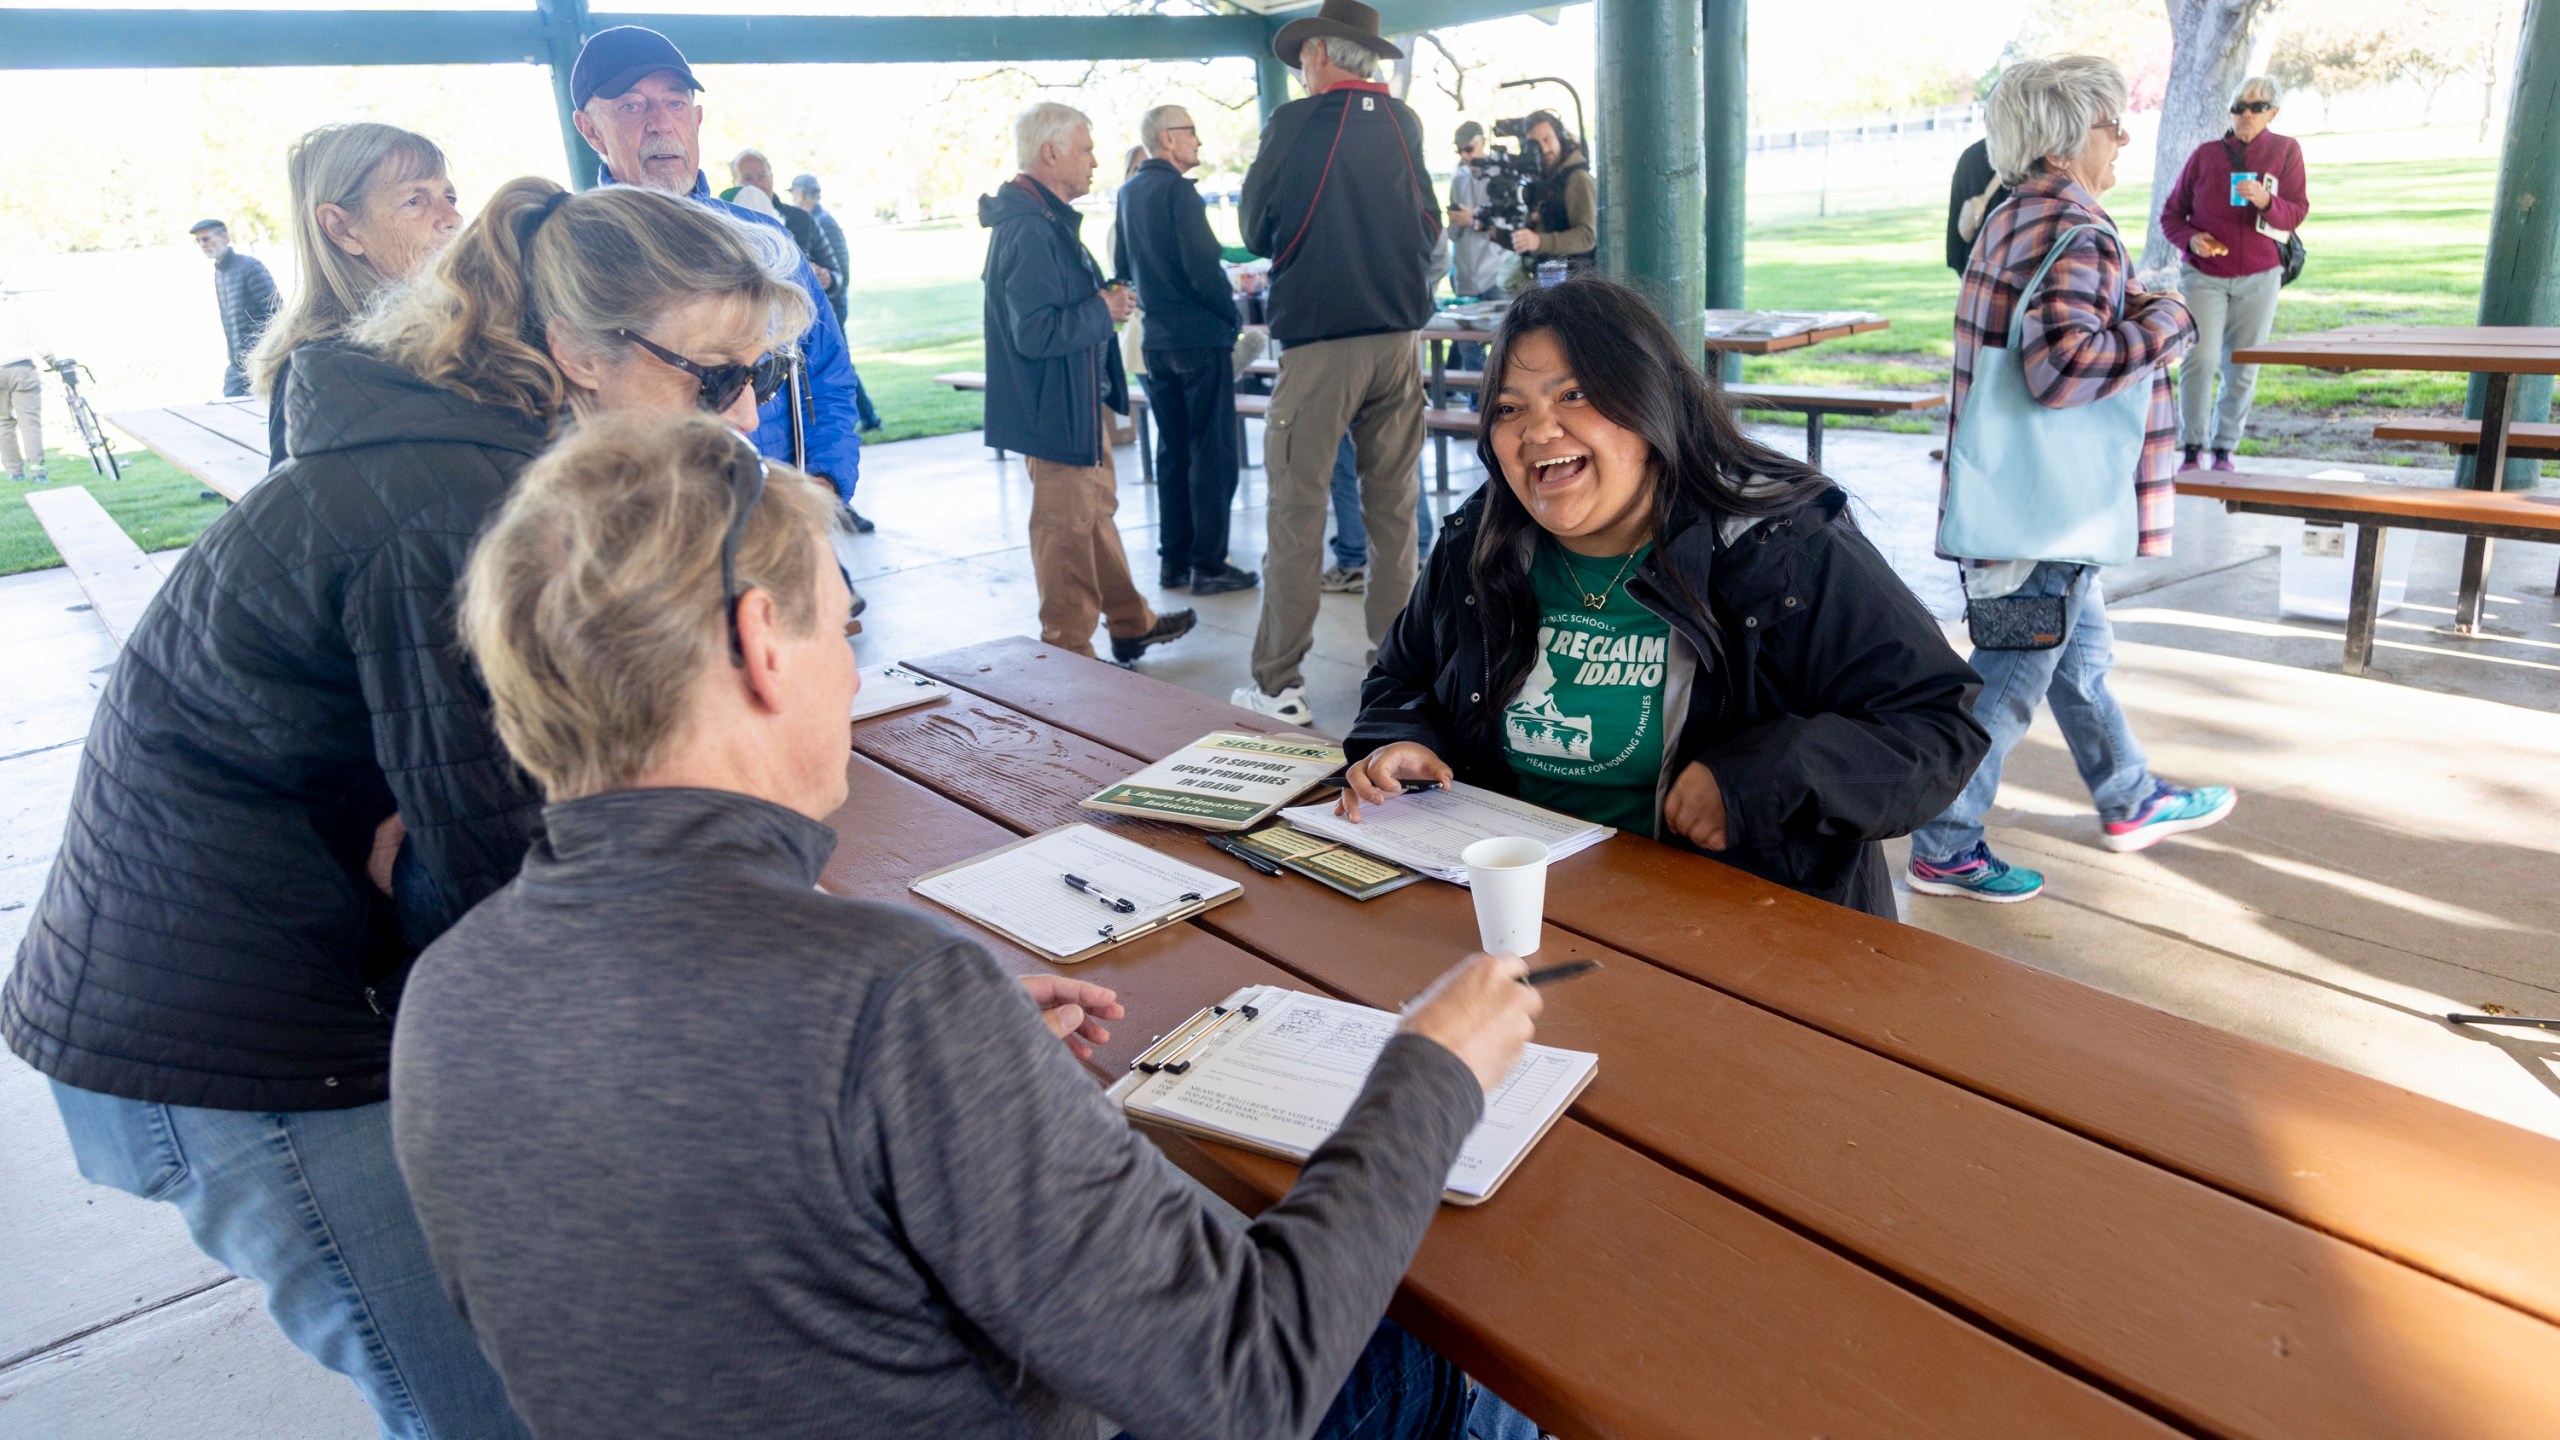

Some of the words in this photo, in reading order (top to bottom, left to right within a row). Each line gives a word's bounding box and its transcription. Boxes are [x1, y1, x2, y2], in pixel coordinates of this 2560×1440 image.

[1570, 614, 1617, 632] SCHOOLS
[1550, 630, 1666, 663] RECLAIM
[1574, 661, 1663, 688] IDAHO
[1216, 739, 1273, 752] SIGN
[1526, 756, 1586, 776] HEALTHCARE
[1588, 763, 1606, 775] FOR
[1635, 694, 1651, 737] FAMILIES
[1207, 755, 1229, 765] TO
[1226, 758, 1297, 773] SUPPORT
[1171, 764, 1213, 775] OPEN
[1209, 769, 1291, 786] PRIMARIES
[1176, 778, 1200, 787] IN
[1194, 780, 1244, 793] IDAHO
[1134, 791, 1175, 801] Open
[1174, 796, 1253, 812] Primaries
